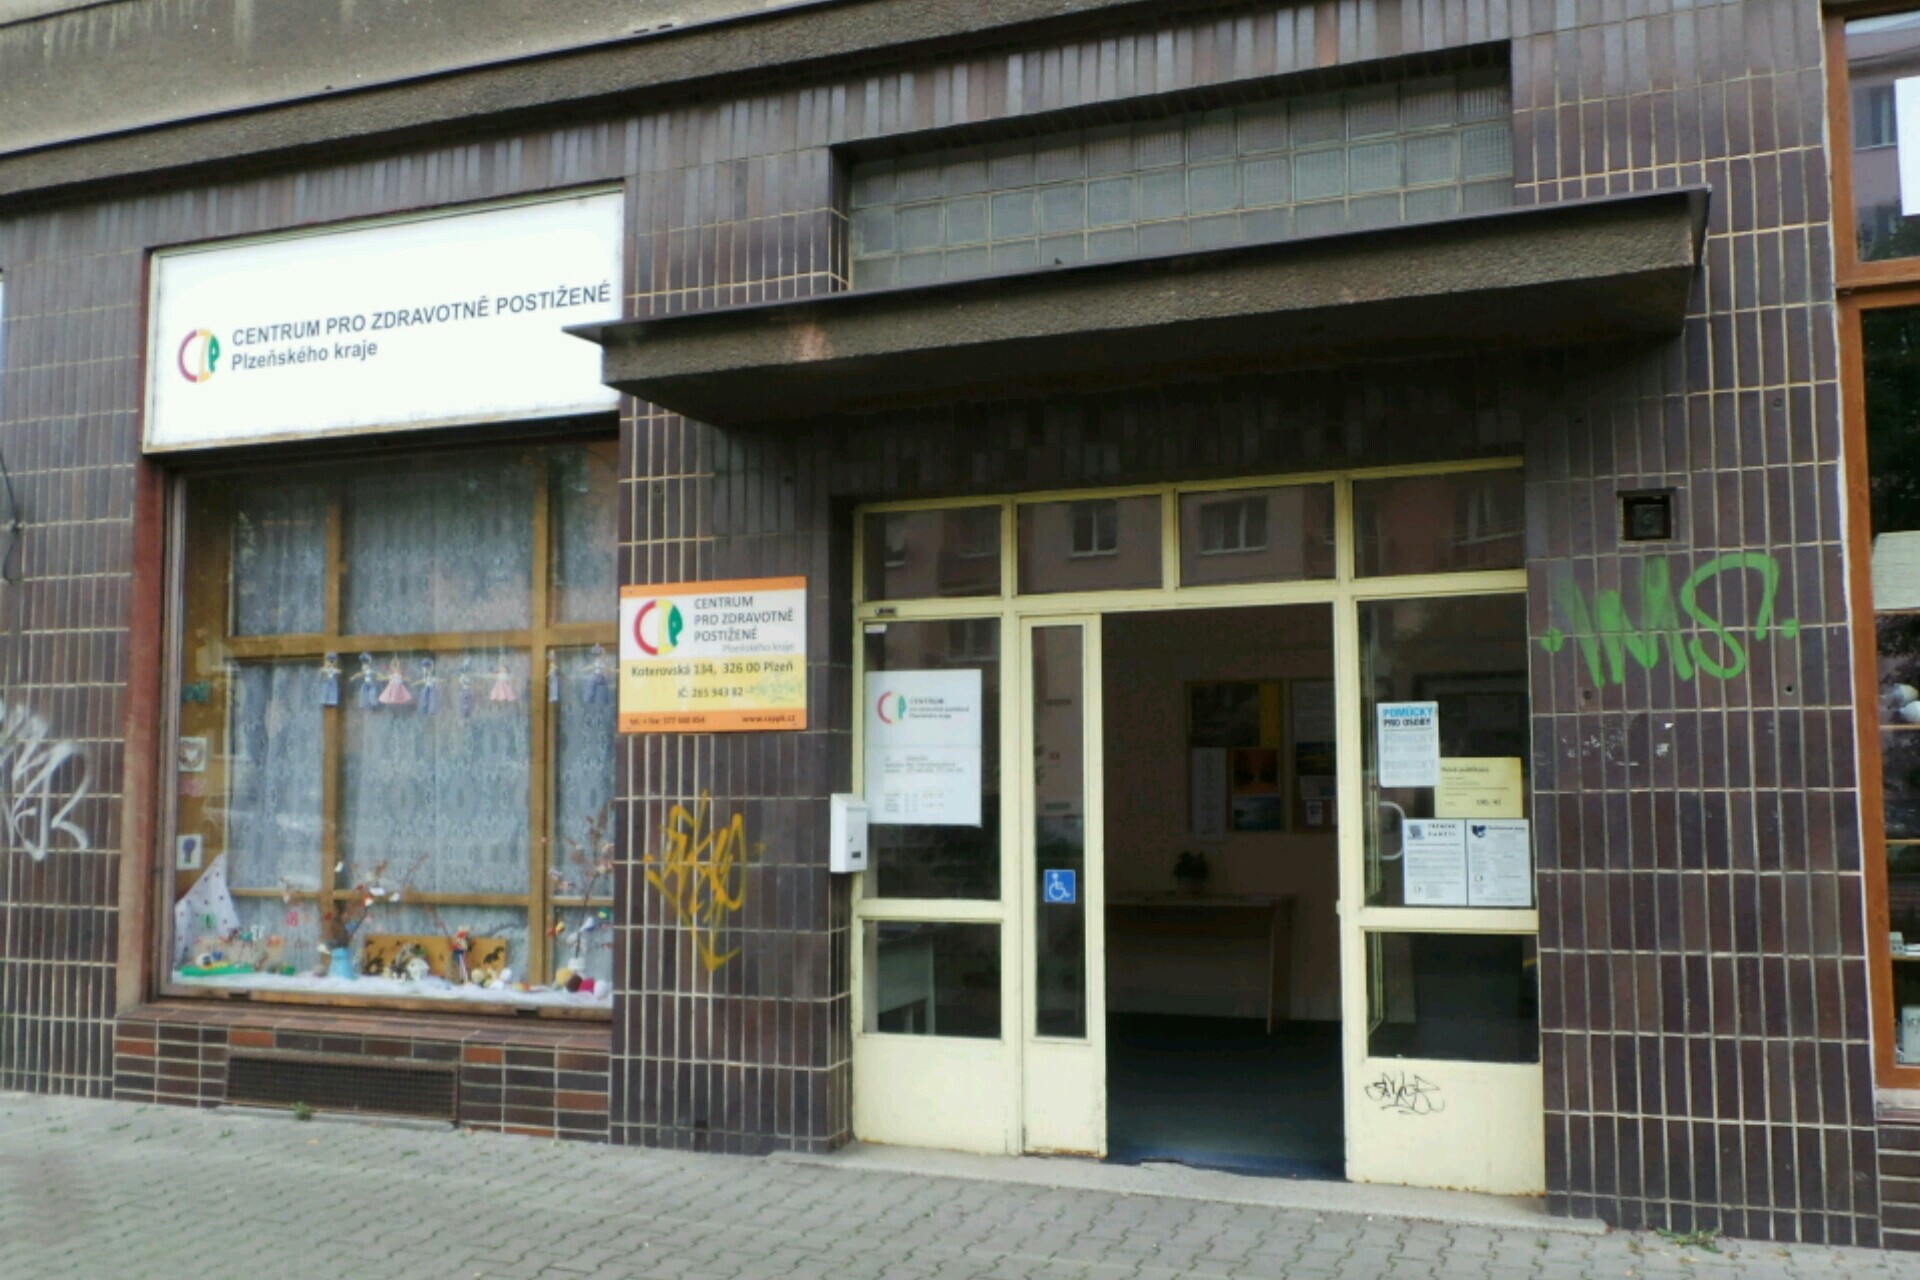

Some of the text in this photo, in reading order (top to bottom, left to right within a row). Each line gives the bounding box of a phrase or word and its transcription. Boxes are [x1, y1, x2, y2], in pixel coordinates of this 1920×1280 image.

[232, 281, 612, 347] CENTRUM PRO ZDRAVOTNĚ POSTIŽENÉ
[231, 339, 379, 372] Plzeňského kraje
[694, 596, 754, 610] CENTRUM
[694, 607, 794, 626] PRO ZDRAVOTNĚ
[694, 627, 757, 642] POSTIŽENÉ
[631, 659, 794, 678] Koterovská 134, 326 00 Plzeň
[1383, 718, 1401, 727] PRO
